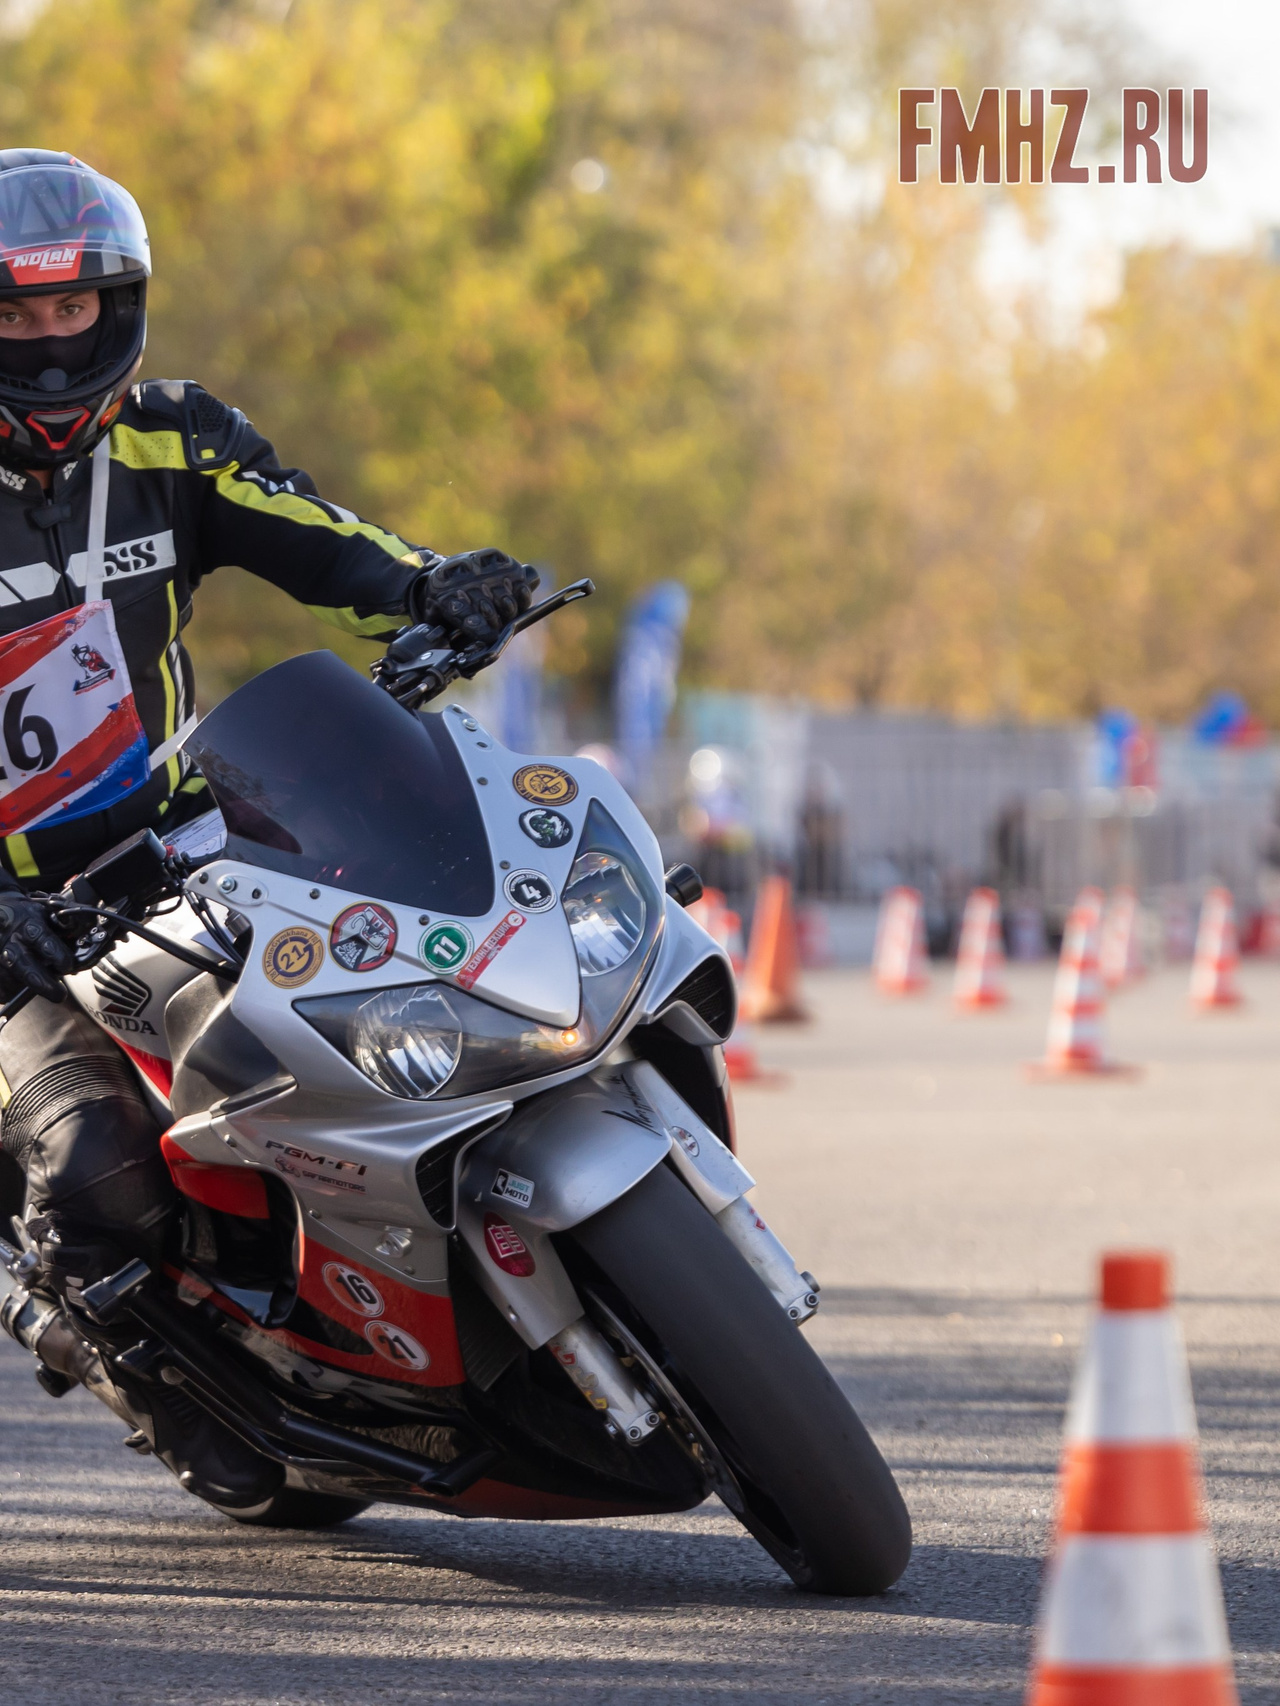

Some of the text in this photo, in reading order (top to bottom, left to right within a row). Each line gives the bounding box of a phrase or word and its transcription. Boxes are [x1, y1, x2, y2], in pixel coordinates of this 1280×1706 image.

[13, 247, 78, 271] NOLAN
[521, 884, 542, 900] 4
[281, 945, 306, 970] 21
[433, 935, 460, 960] 11
[266, 1140, 368, 1176] PGM-FI
[504, 1187, 529, 1203] MOTO
[508, 1180, 530, 1193] JUST
[336, 1274, 377, 1304] 16
[378, 1335, 417, 1359] 21
